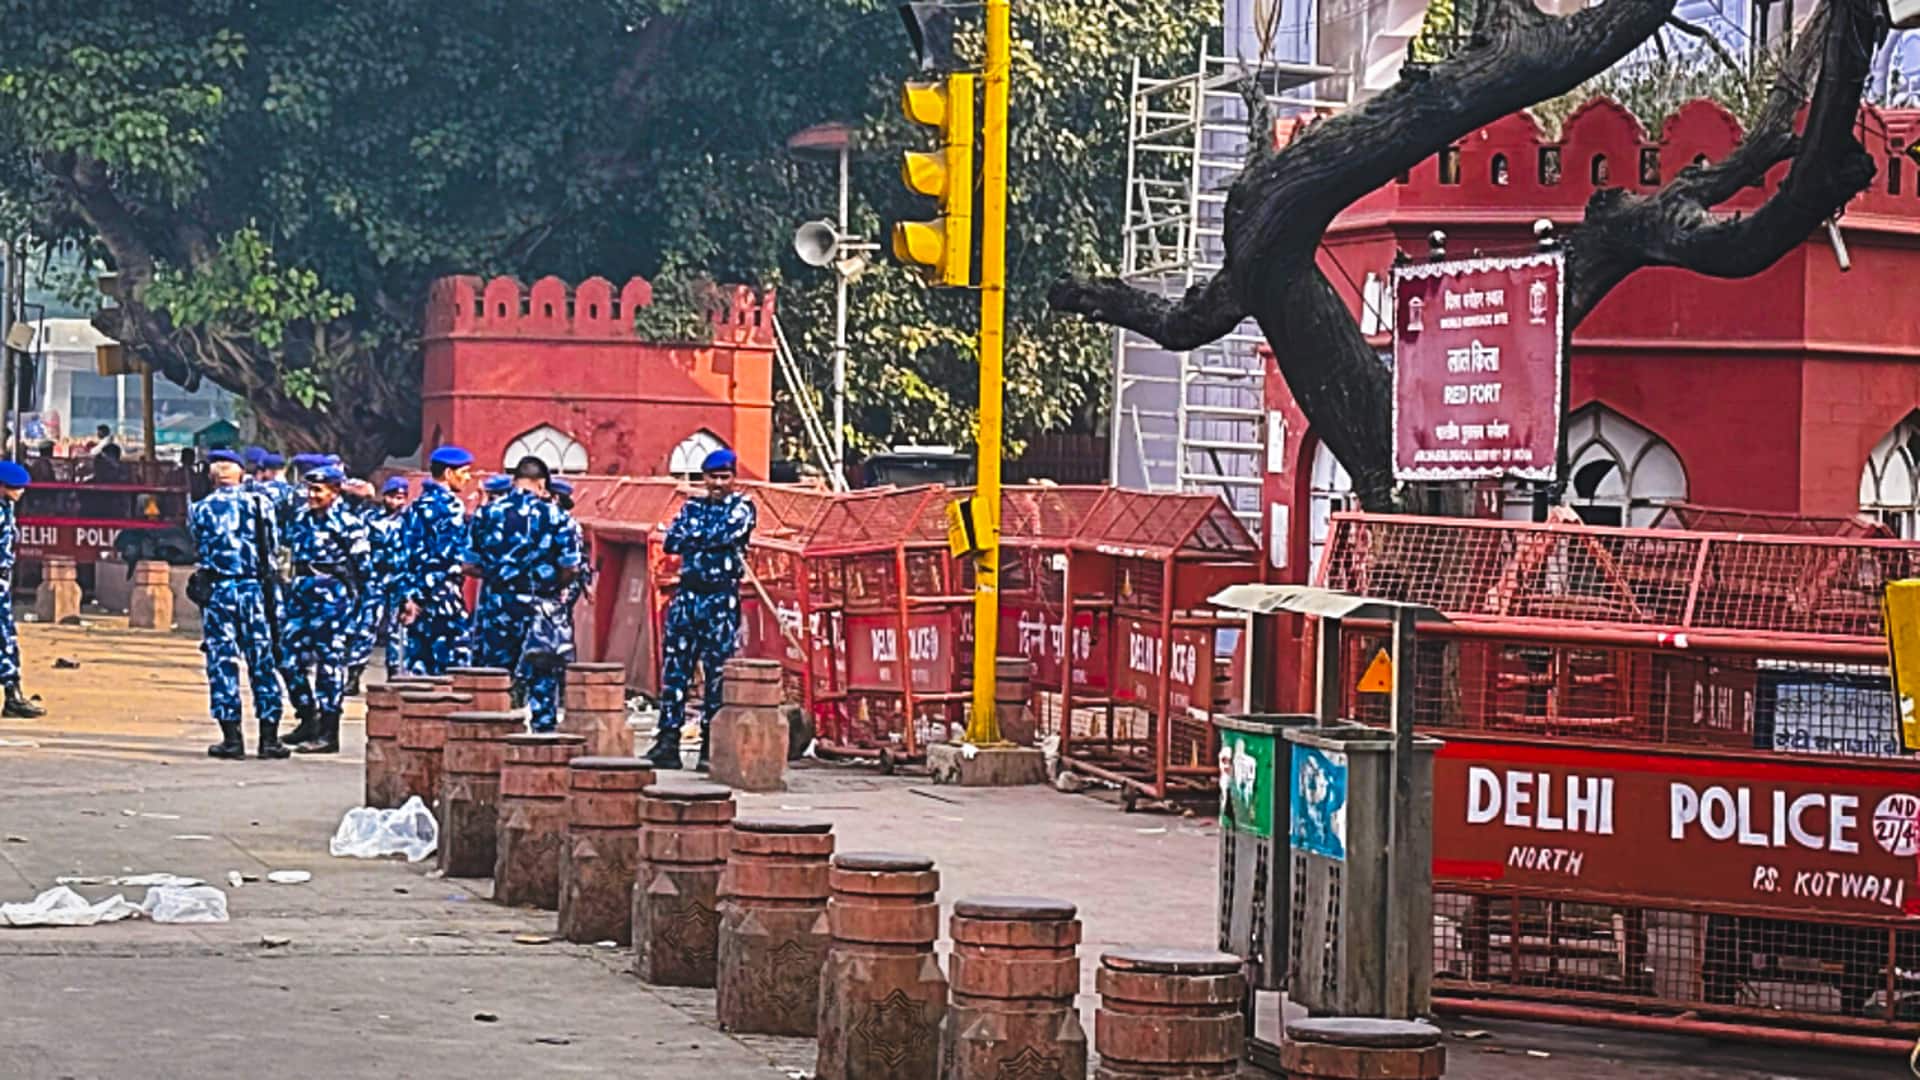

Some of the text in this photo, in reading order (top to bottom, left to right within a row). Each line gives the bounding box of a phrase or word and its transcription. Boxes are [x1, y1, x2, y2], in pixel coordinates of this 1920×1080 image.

[1444, 383, 1502, 404] RED FORT
[76, 527, 121, 547] POLI
[1693, 680, 1733, 730] DLHI
[1467, 767, 1859, 854] DELHI POLICE
[1888, 797, 1916, 817] ND
[1508, 846, 1583, 877] NORTH
[1794, 871, 1904, 908] KOTWALI
